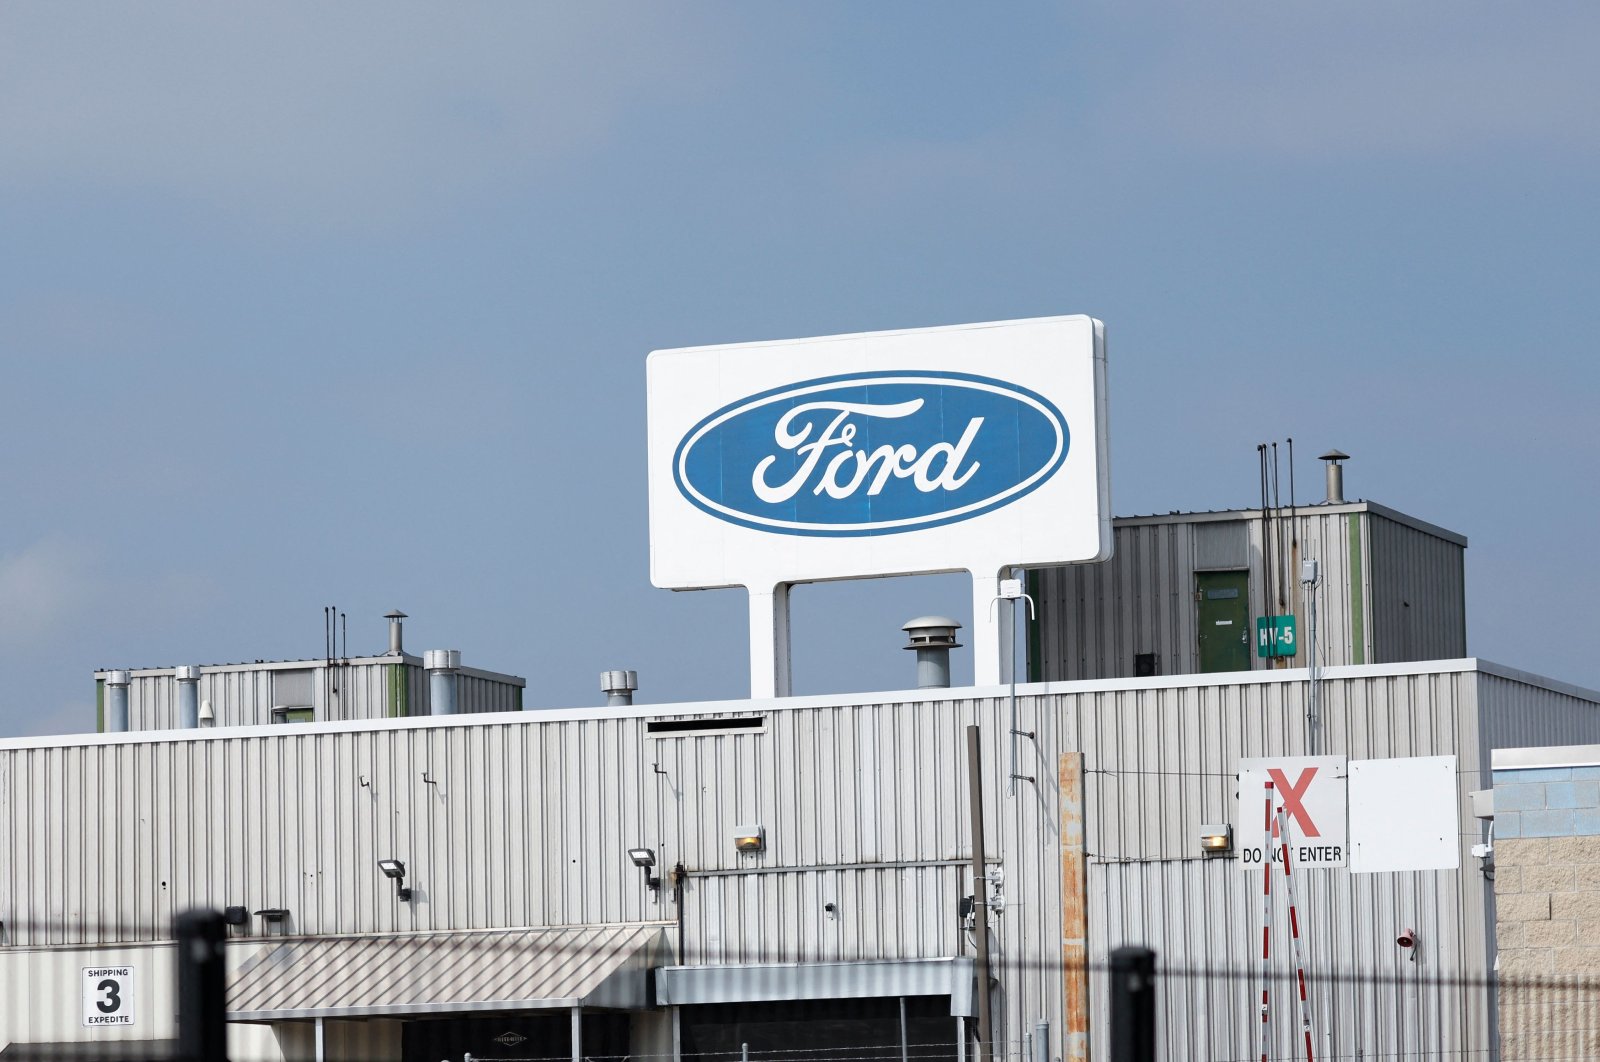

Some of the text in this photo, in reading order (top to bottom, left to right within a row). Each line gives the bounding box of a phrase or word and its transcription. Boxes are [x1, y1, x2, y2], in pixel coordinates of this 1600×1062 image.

[752, 398, 985, 503] Ford
[1260, 626, 1294, 646] HV-5
[1243, 847, 1262, 863] DO
[1299, 846, 1342, 862] ENTER
[88, 969, 129, 977] SHIPPING
[96, 978, 121, 1014] 3
[88, 1015, 130, 1024] EXPEDITE
